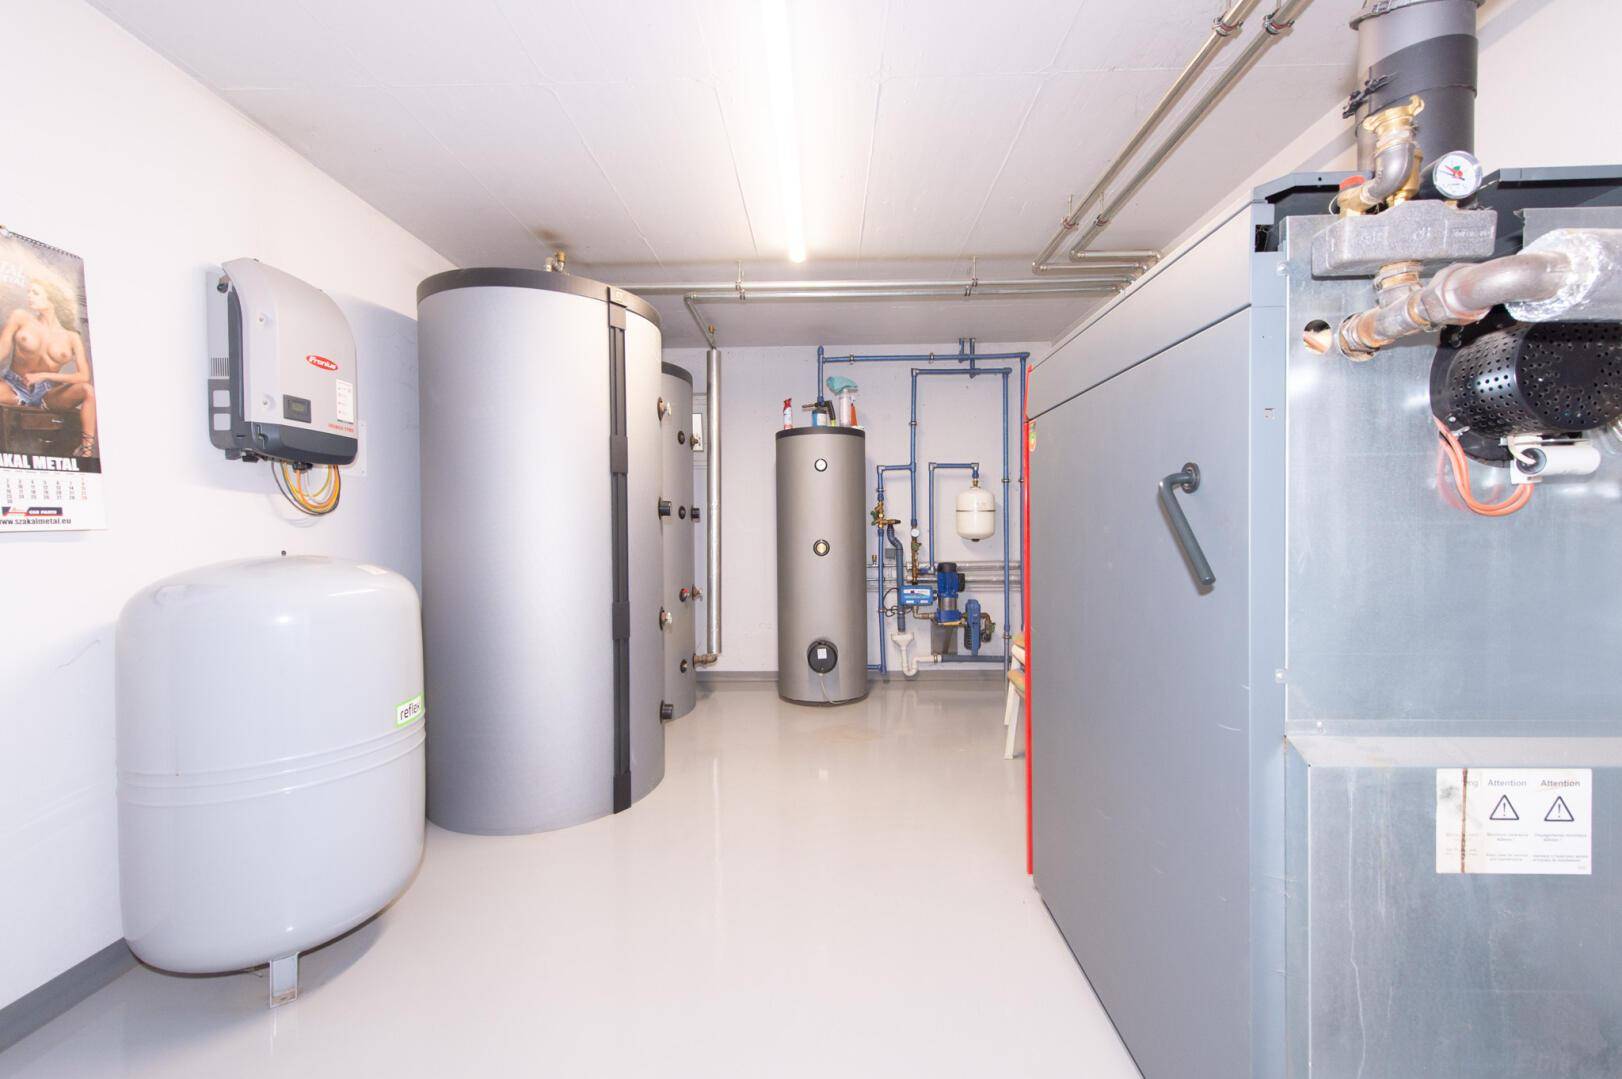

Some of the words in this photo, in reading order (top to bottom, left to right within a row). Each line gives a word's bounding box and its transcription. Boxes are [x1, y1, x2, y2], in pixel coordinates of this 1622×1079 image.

[309, 356, 336, 370] Fronius
[32, 455, 80, 471] METAL
[1488, 778, 1527, 787] Attention
[1540, 779, 1581, 788] Attention
